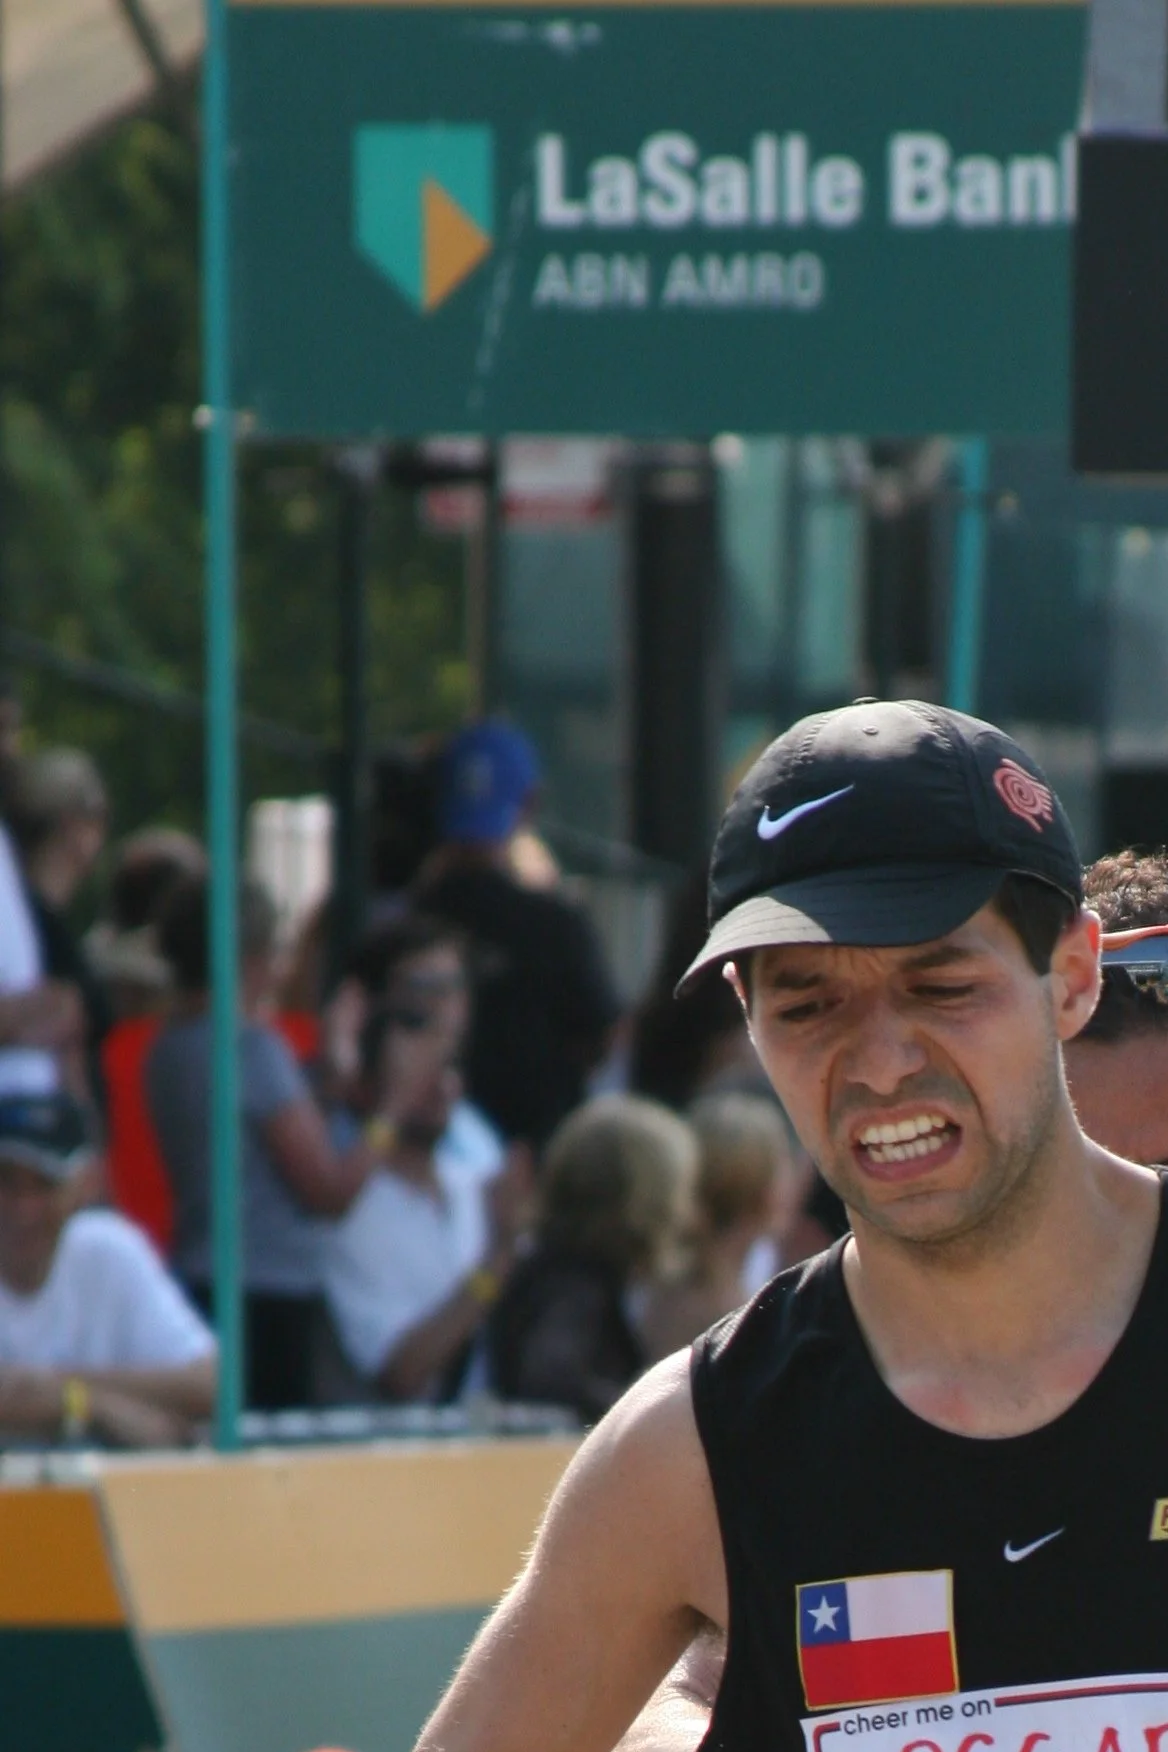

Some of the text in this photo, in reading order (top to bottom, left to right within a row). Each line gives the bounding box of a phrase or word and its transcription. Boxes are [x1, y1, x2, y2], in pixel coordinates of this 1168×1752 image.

[536, 131, 862, 229] LaSalle
[533, 254, 823, 309] ABN AMRO
[843, 1698, 992, 1736] cheer me on
